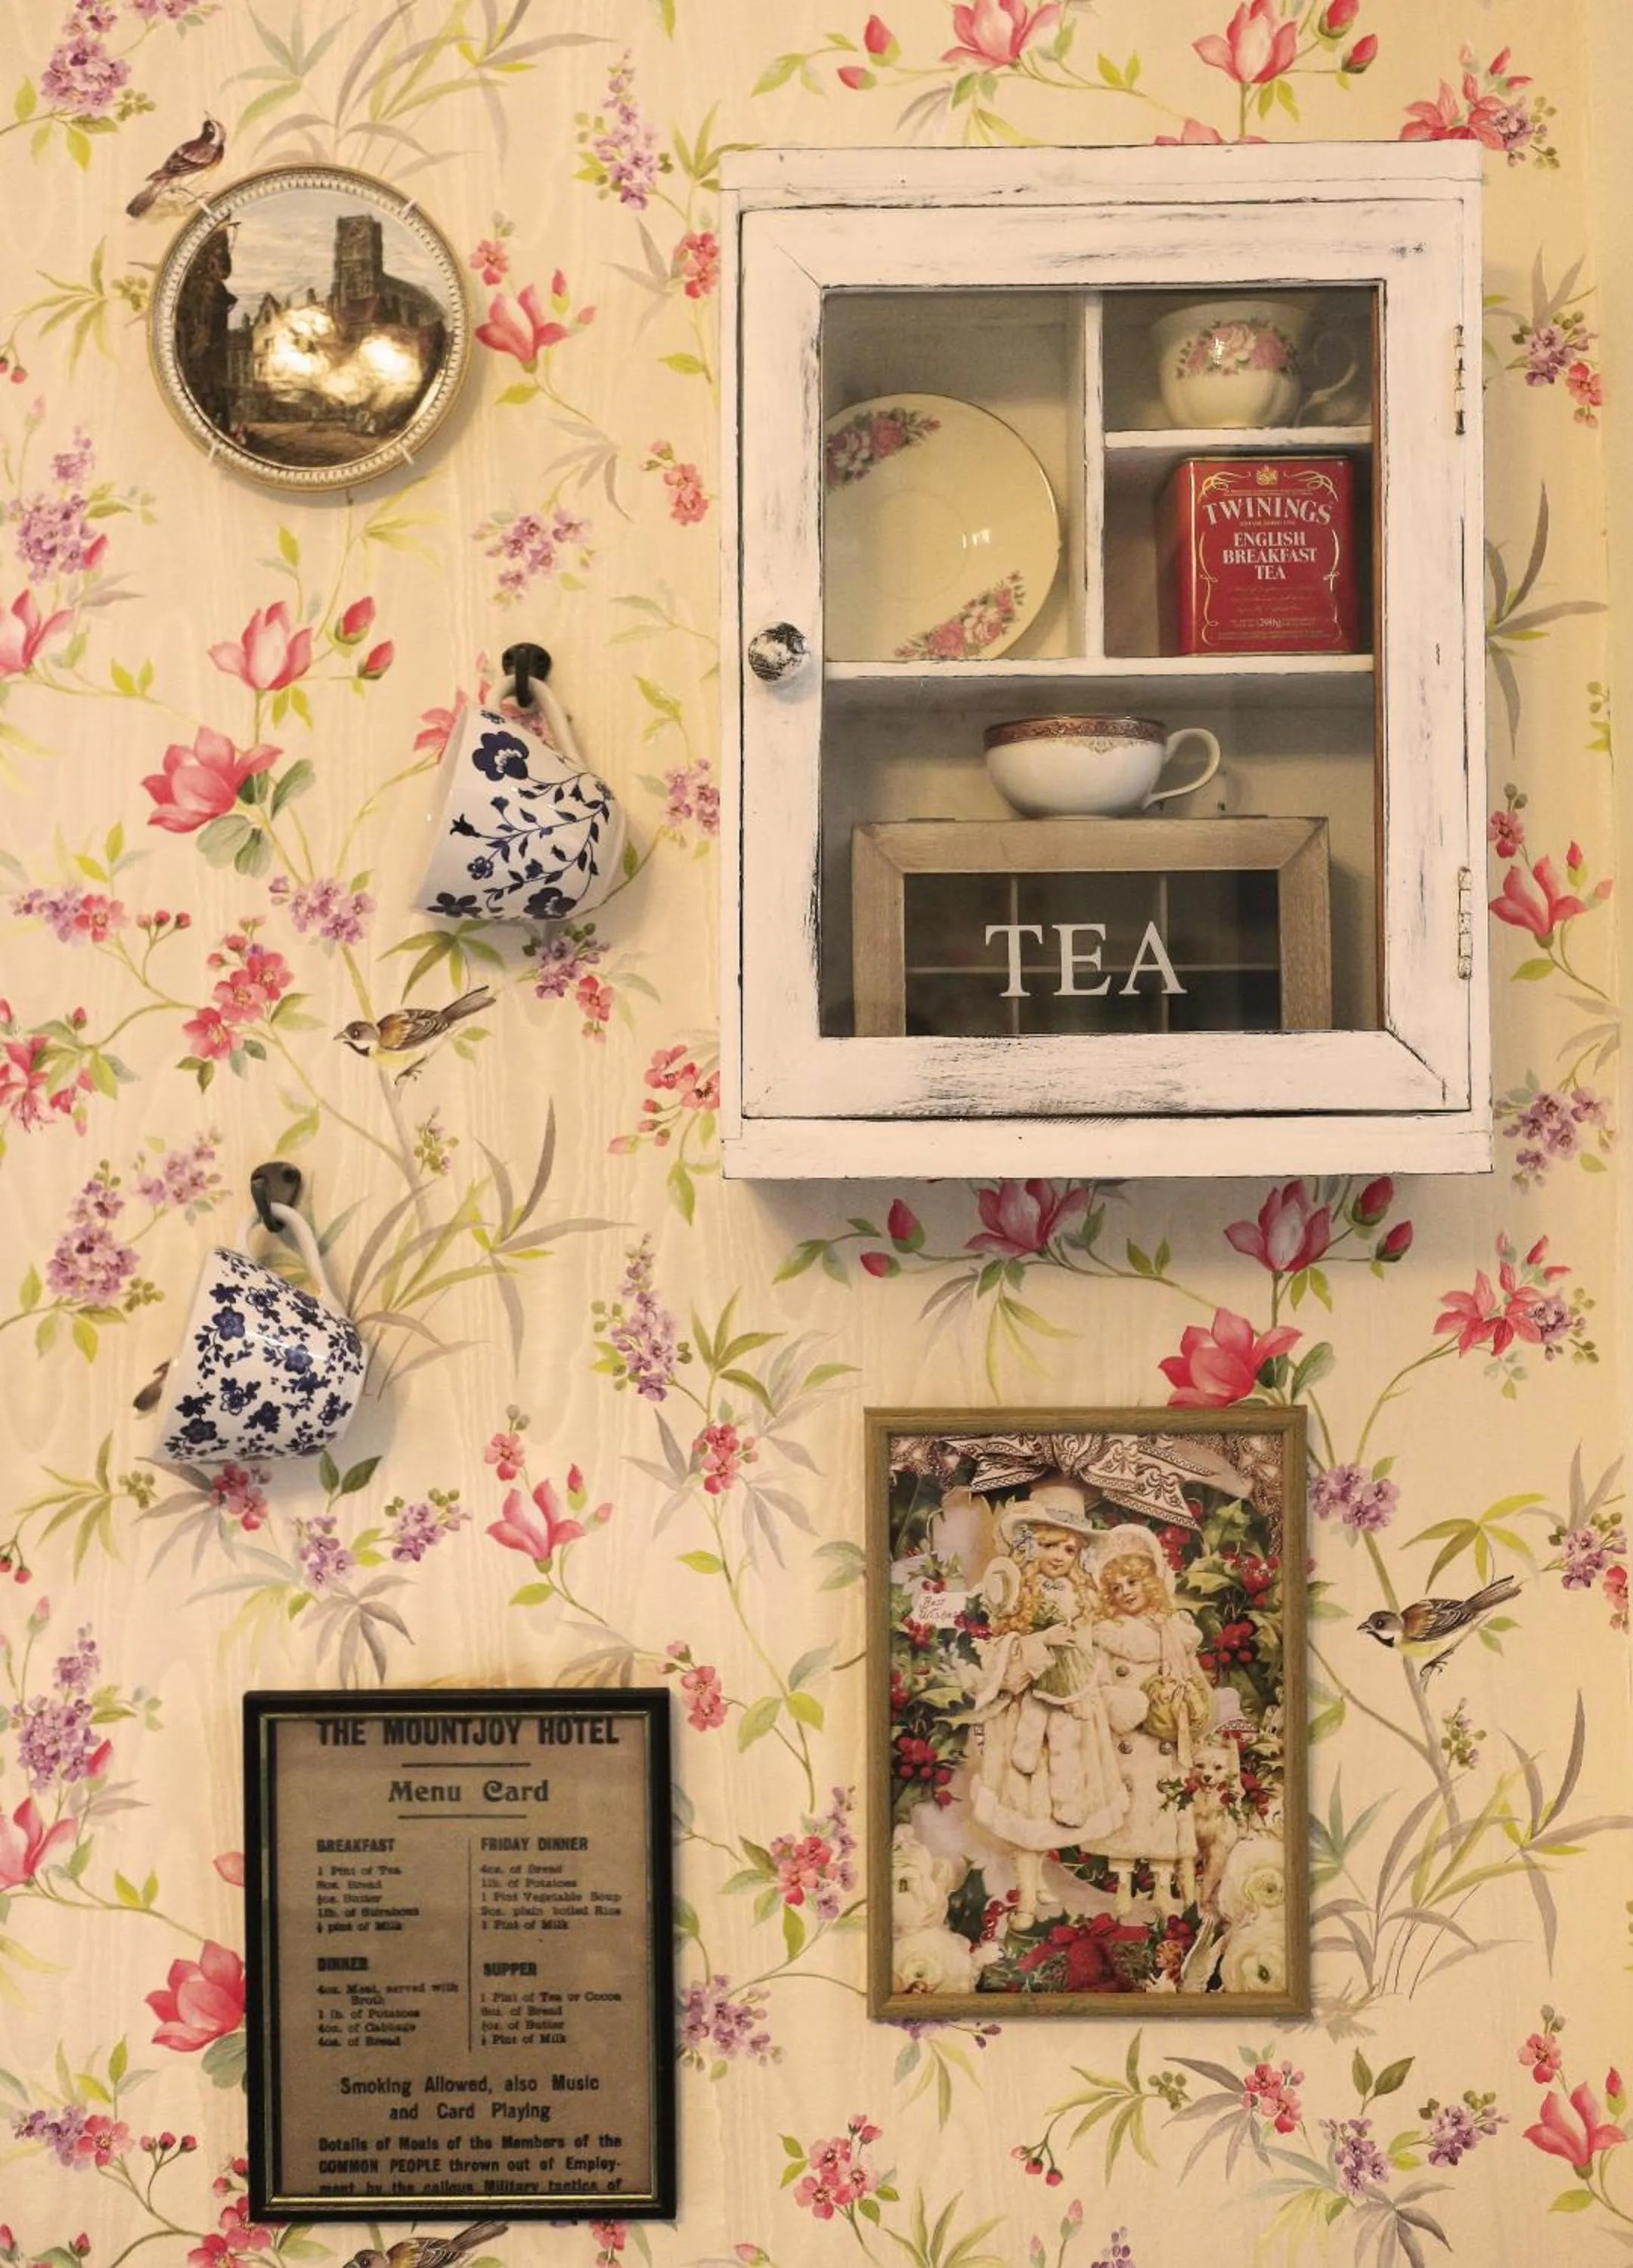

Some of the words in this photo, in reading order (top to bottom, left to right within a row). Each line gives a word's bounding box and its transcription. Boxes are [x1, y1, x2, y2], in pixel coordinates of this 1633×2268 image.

[1203, 496, 1333, 525] TWININGS
[1234, 532, 1306, 547] ENGLISH
[1222, 547, 1317, 564] BREAKFAST
[1255, 565, 1286, 580] TEA
[985, 921, 1188, 997] TEA
[317, 1718, 366, 1745] THE
[384, 1718, 523, 1745] MOUNTJOY
[538, 1718, 618, 1744] HOTEL
[389, 1780, 461, 1802] Menu
[483, 1780, 549, 1802] Card
[317, 1839, 395, 1852] BREAKFAST
[481, 1837, 529, 1851] FRIDAY
[538, 1837, 588, 1851] DINNER
[361, 1867, 372, 1876] of
[510, 1865, 522, 1873] of
[525, 1879, 577, 1887] Potatoes
[523, 1892, 582, 1902] Vegetable
[591, 1892, 621, 1902] Soup
[523, 1920, 536, 1929] of
[542, 1919, 569, 1929] Milk
[318, 1957, 368, 1972] DINNER
[483, 1962, 537, 1975] SUPPER
[432, 1983, 458, 1992] with
[523, 1993, 535, 2002] of
[540, 1992, 562, 2002] Tea
[584, 1991, 621, 2001] Cocoa
[351, 2009, 363, 2019] of
[369, 2009, 420, 2018] Potatoes
[510, 2006, 521, 2015] of
[348, 2024, 360, 2032] of
[508, 2021, 519, 2030] of
[526, 2021, 565, 2030] Butter
[348, 2037, 359, 2046] of
[522, 2035, 534, 2044] of
[540, 2034, 566, 2043] Milk
[340, 2077, 411, 2097] Smoking
[425, 2075, 492, 2095] Allowed,
[504, 2075, 538, 2092] also
[552, 2074, 600, 2091] Music
[389, 2102, 419, 2121] and
[437, 2102, 475, 2120] Card
[491, 2102, 551, 2123] Playing
[318, 2136, 368, 2152] Details
[376, 2136, 392, 2151] of
[399, 2136, 439, 2150] Meals
[448, 2135, 462, 2151] of
[470, 2136, 493, 2149] the
[501, 2134, 565, 2149] Members
[574, 2133, 590, 2148] of
[599, 2132, 622, 2148] the
[318, 2159, 378, 2174] COMMON
[389, 2158, 442, 2174] PEOPLE
[449, 2158, 500, 2173] thrown
[507, 2157, 530, 2172] out
[539, 2156, 555, 2171] of
[566, 2155, 622, 2173] Employ-
[607, 2176, 623, 2192] of
